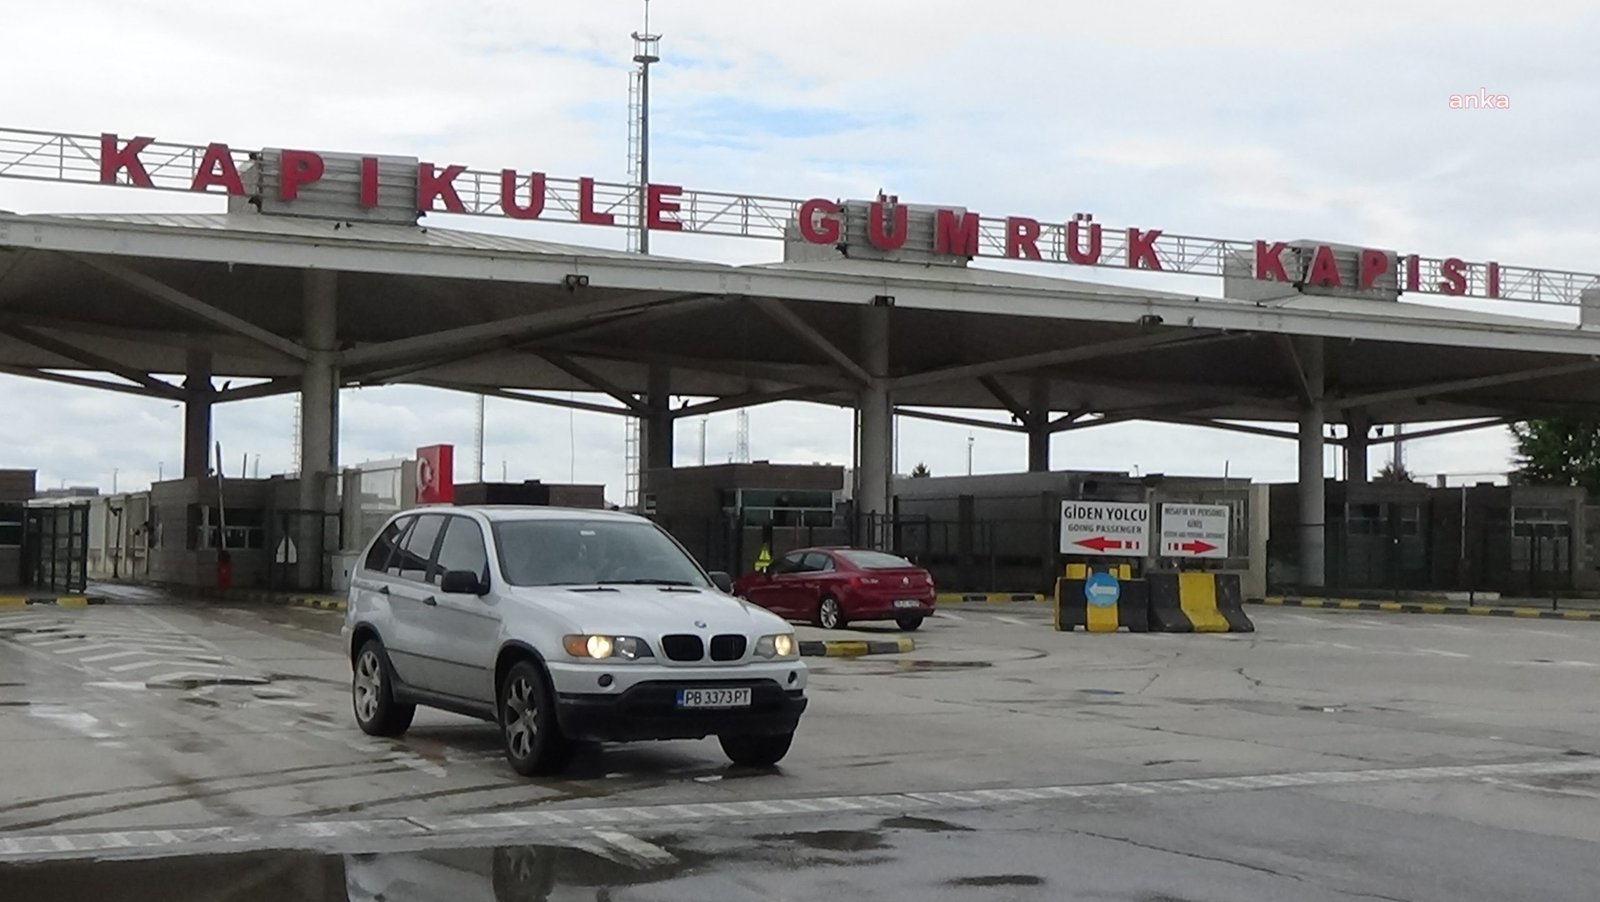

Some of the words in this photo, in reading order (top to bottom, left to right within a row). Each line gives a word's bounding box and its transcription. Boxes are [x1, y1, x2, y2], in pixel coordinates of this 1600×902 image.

[100, 133, 683, 231] KAPIKULE
[798, 194, 1163, 270] GÜMRÜK
[1254, 240, 1499, 298] KAPISI
[1064, 504, 1102, 520] GİDEN
[1106, 507, 1147, 521] YOLCU
[1068, 524, 1094, 532] GOING
[1096, 525, 1142, 534] PASSENGER
[686, 691, 701, 704] PB
